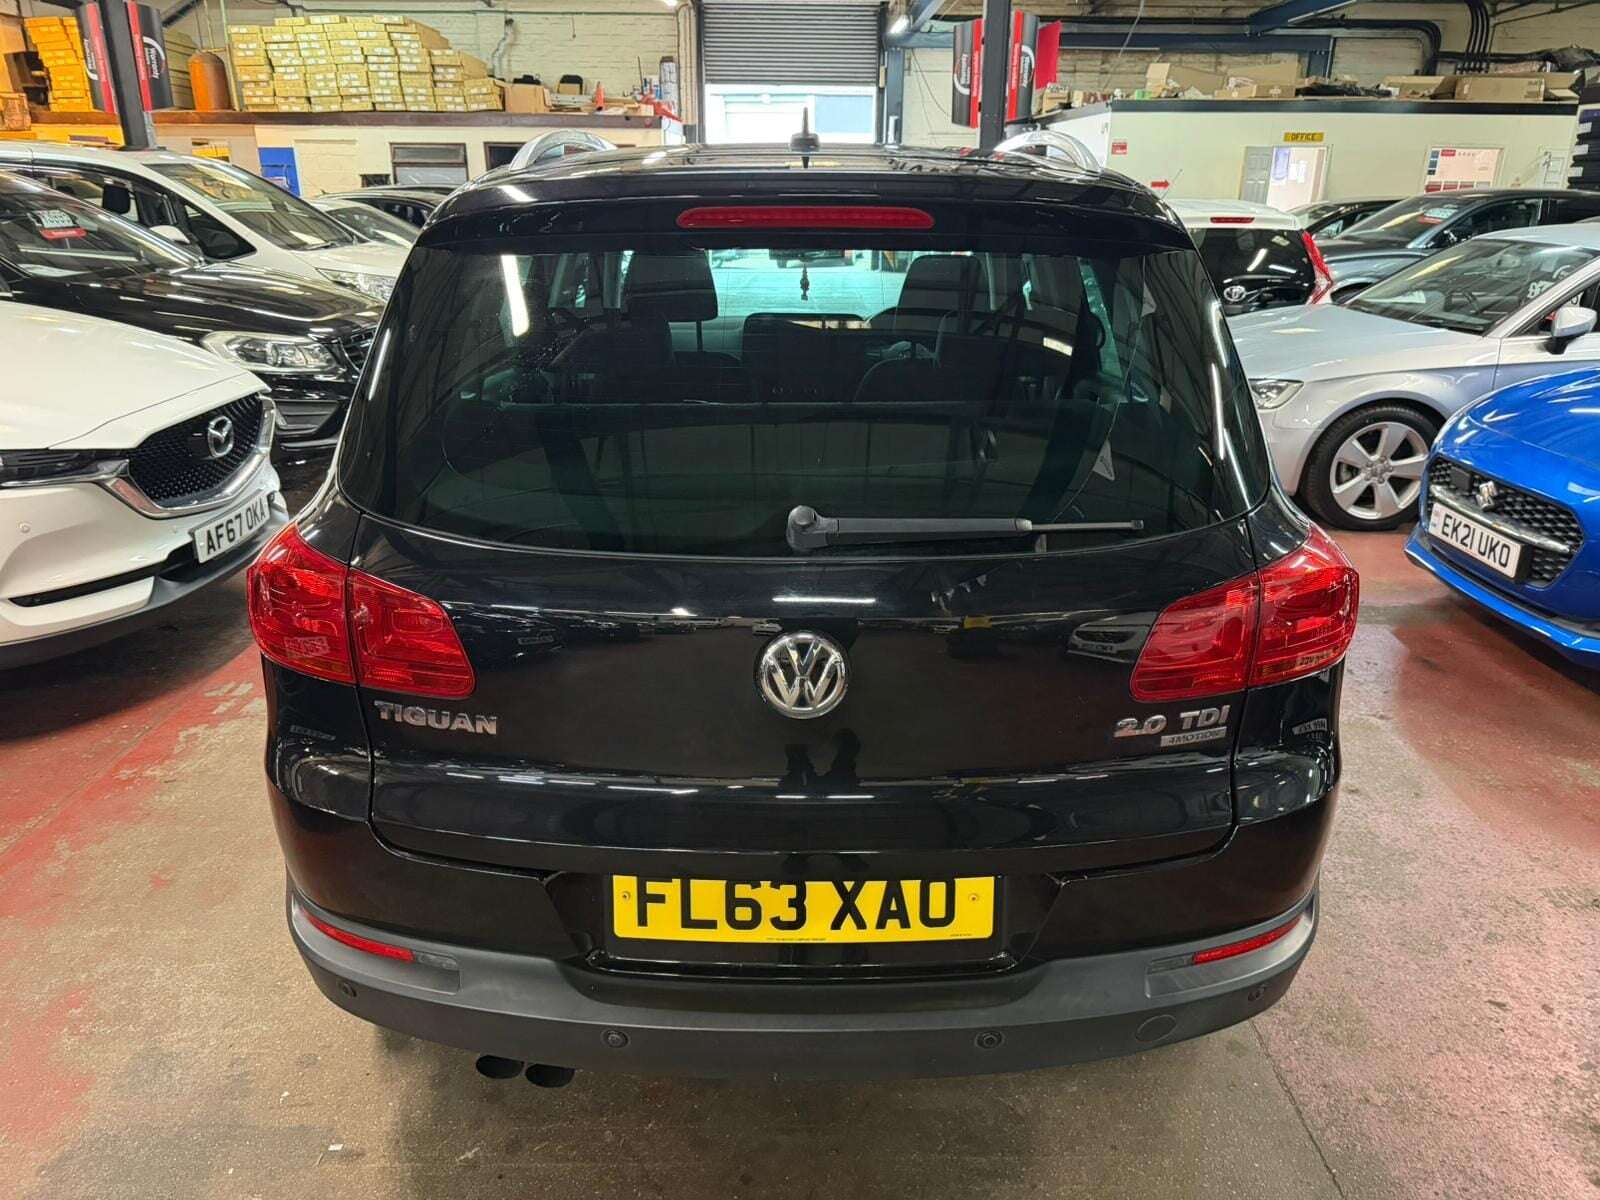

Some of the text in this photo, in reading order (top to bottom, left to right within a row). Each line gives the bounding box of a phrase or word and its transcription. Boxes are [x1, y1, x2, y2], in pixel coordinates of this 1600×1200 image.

[1290, 132, 1316, 142] OFFICE
[204, 497, 267, 556] AF67 OKA
[1441, 512, 1512, 568] EK21 UKO
[374, 700, 498, 735] TIGUAN
[1114, 705, 1231, 738] 2.0 TDI
[1167, 728, 1222, 746] 4MOTION
[637, 877, 956, 931] FL63 XAO
